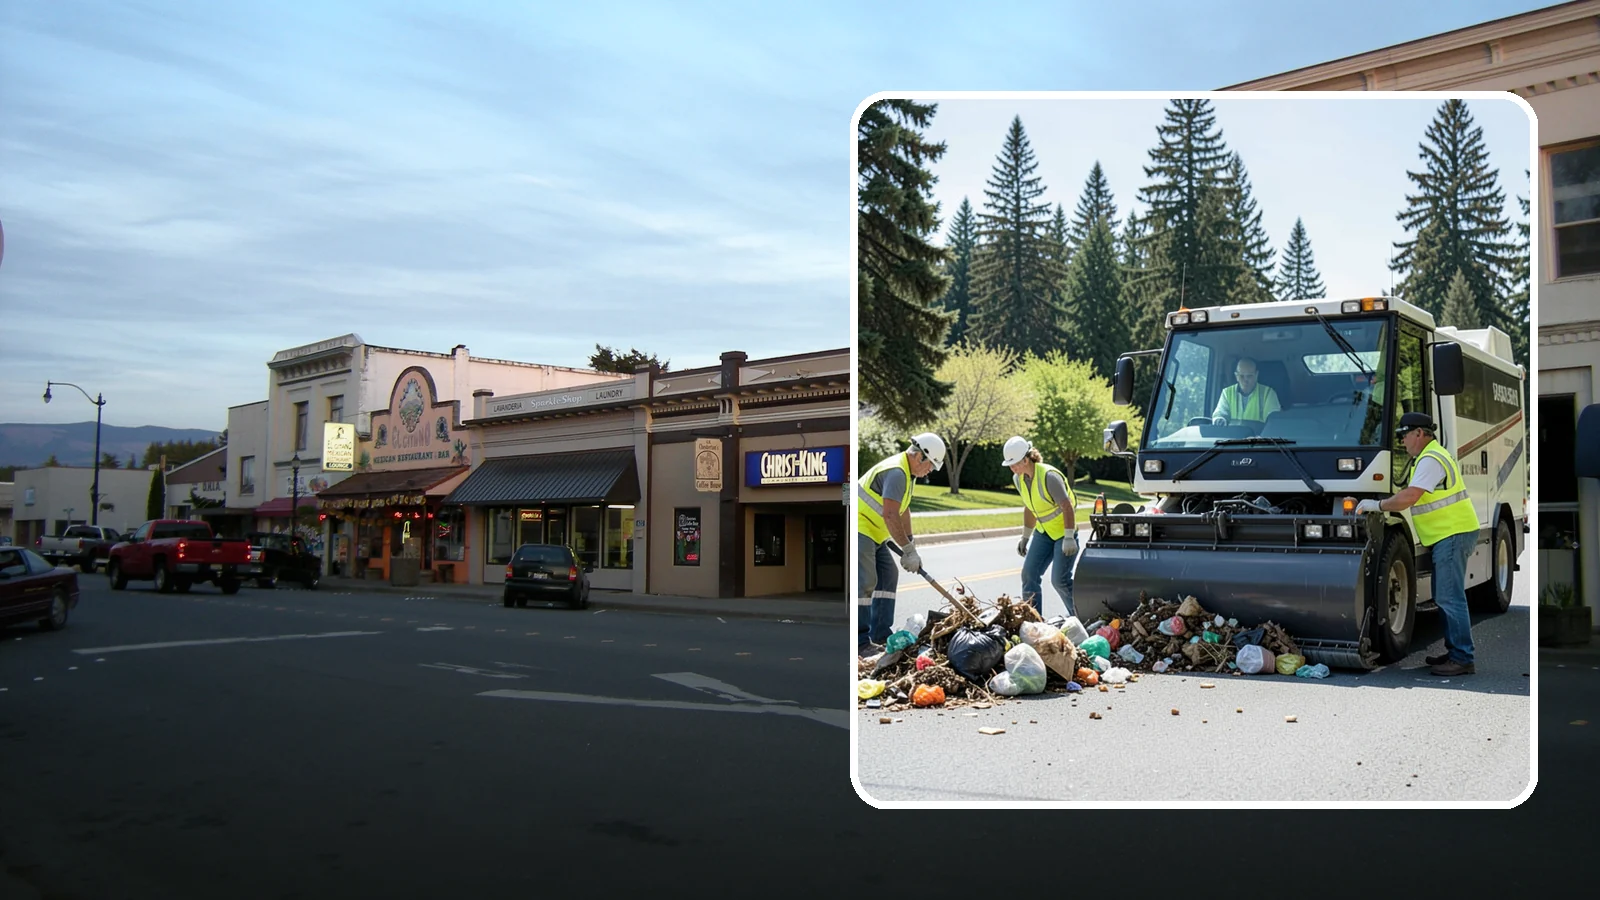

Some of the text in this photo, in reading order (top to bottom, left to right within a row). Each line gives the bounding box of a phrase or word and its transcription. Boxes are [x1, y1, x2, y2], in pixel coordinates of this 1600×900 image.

[530, 394, 583, 408] Sparkle Shop
[595, 389, 623, 400] LAUNDRY
[493, 402, 522, 413] LAVANDERIA
[373, 454, 396, 464] MEXICAN
[397, 451, 433, 462] RESTAURANT
[437, 450, 450, 459] BAR
[761, 449, 828, 477] CHRIST KING
